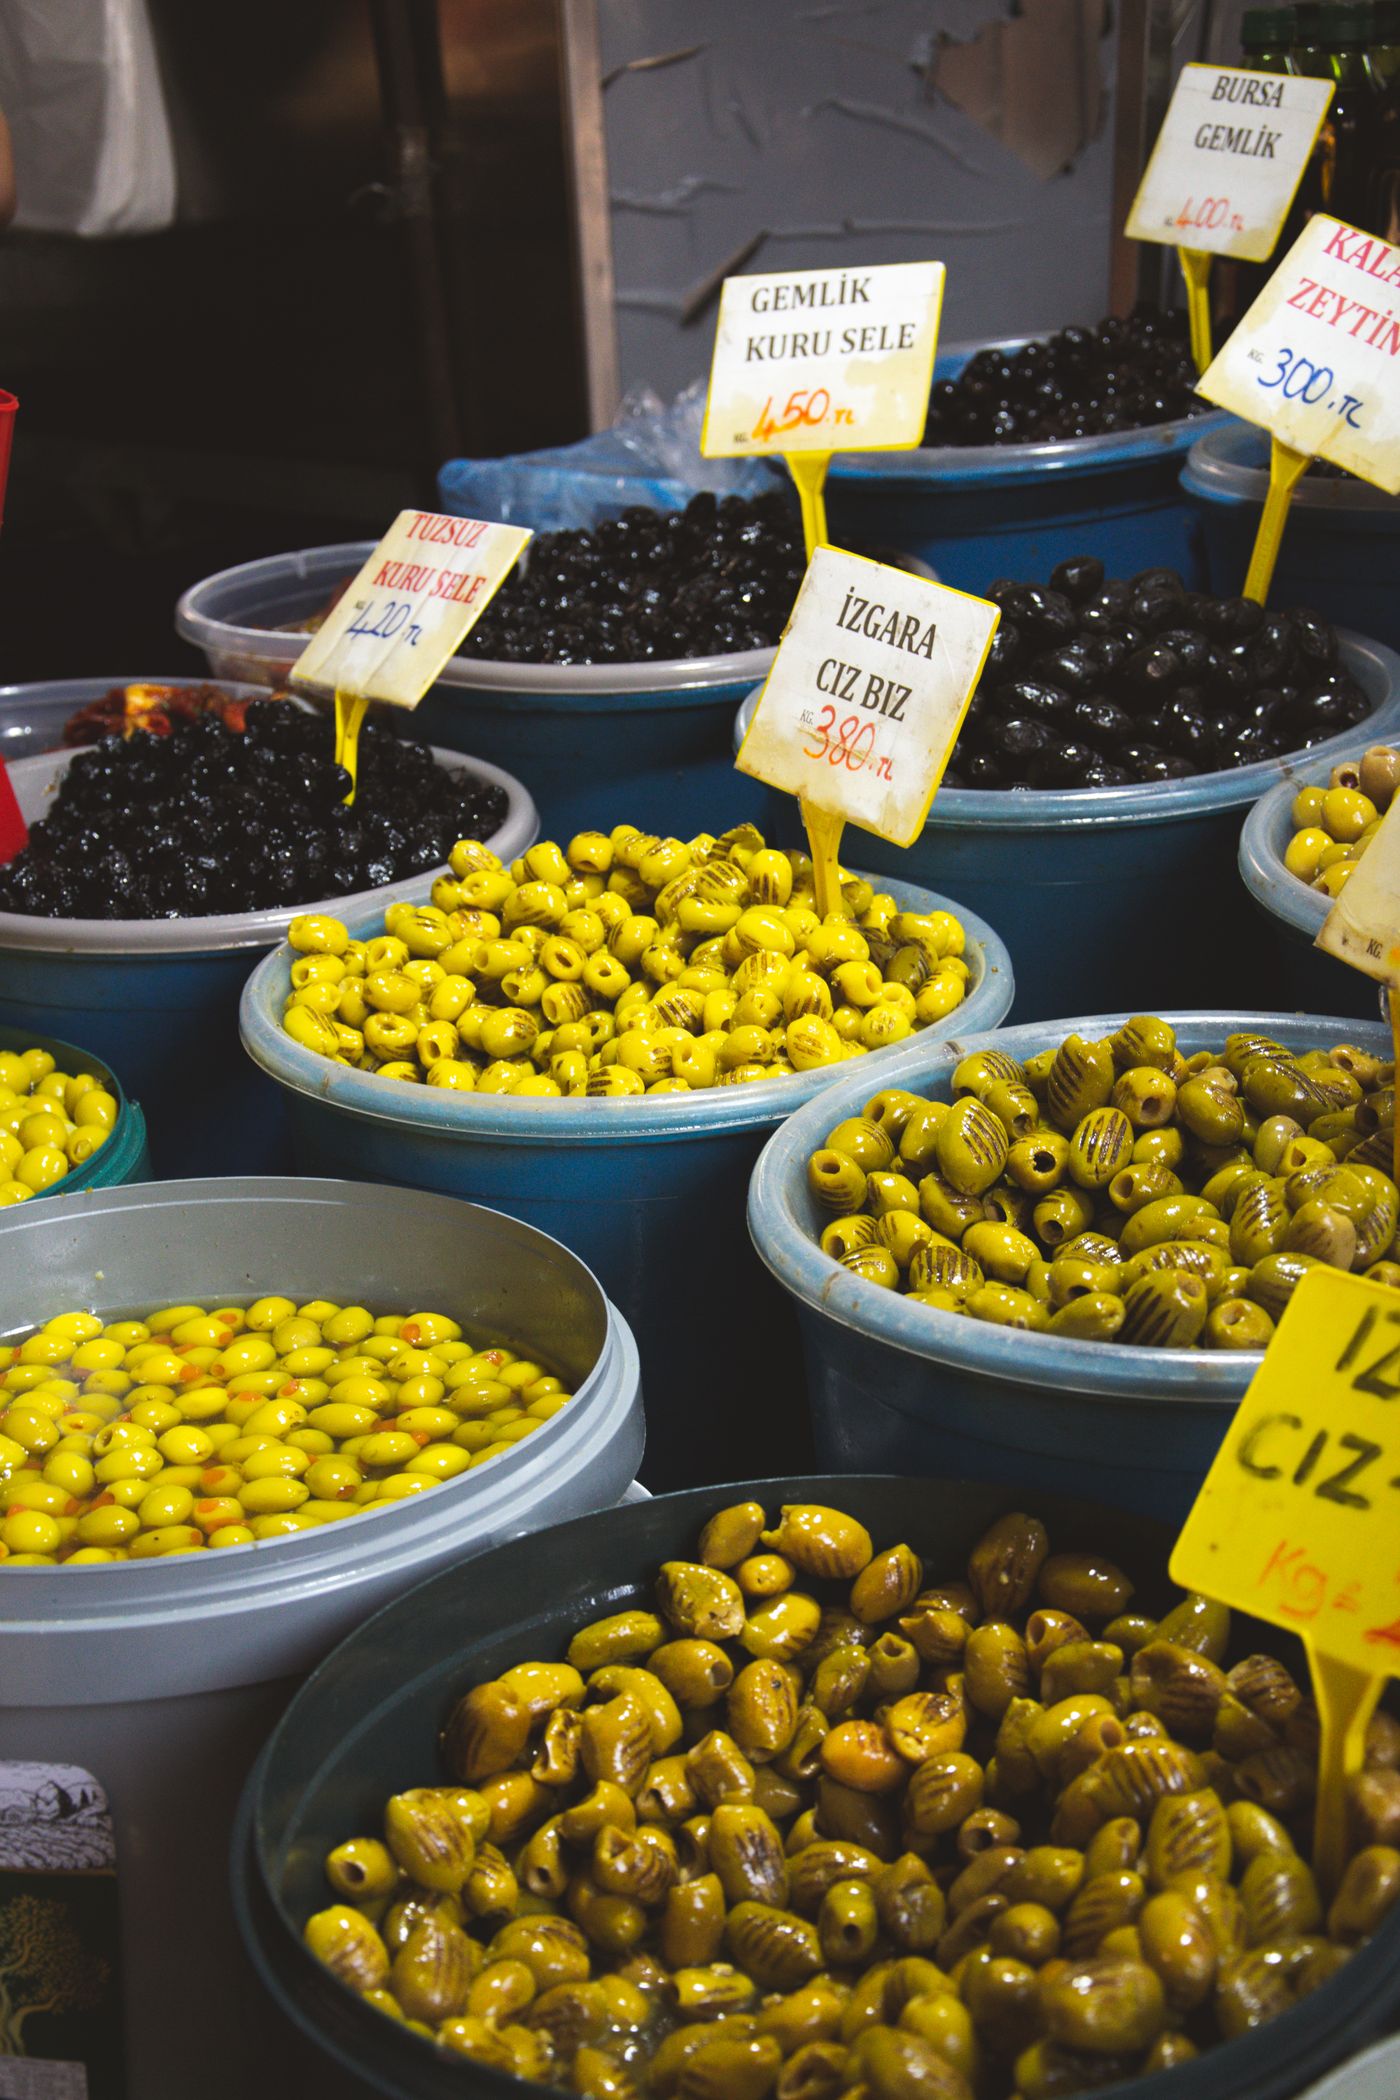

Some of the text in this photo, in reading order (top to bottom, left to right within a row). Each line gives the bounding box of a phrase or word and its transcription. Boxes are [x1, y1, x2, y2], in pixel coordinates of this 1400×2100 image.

[1211, 75, 1285, 108] BURSA
[1194, 124, 1282, 159] GEMLİK
[751, 273, 872, 314] GEMLİK
[745, 323, 917, 362] KURU SELE
[406, 513, 489, 549] TUZSUZ
[372, 560, 487, 604] KURU SELE
[836, 586, 938, 660] İZGARA
[816, 658, 913, 722] CIZ BIZ
